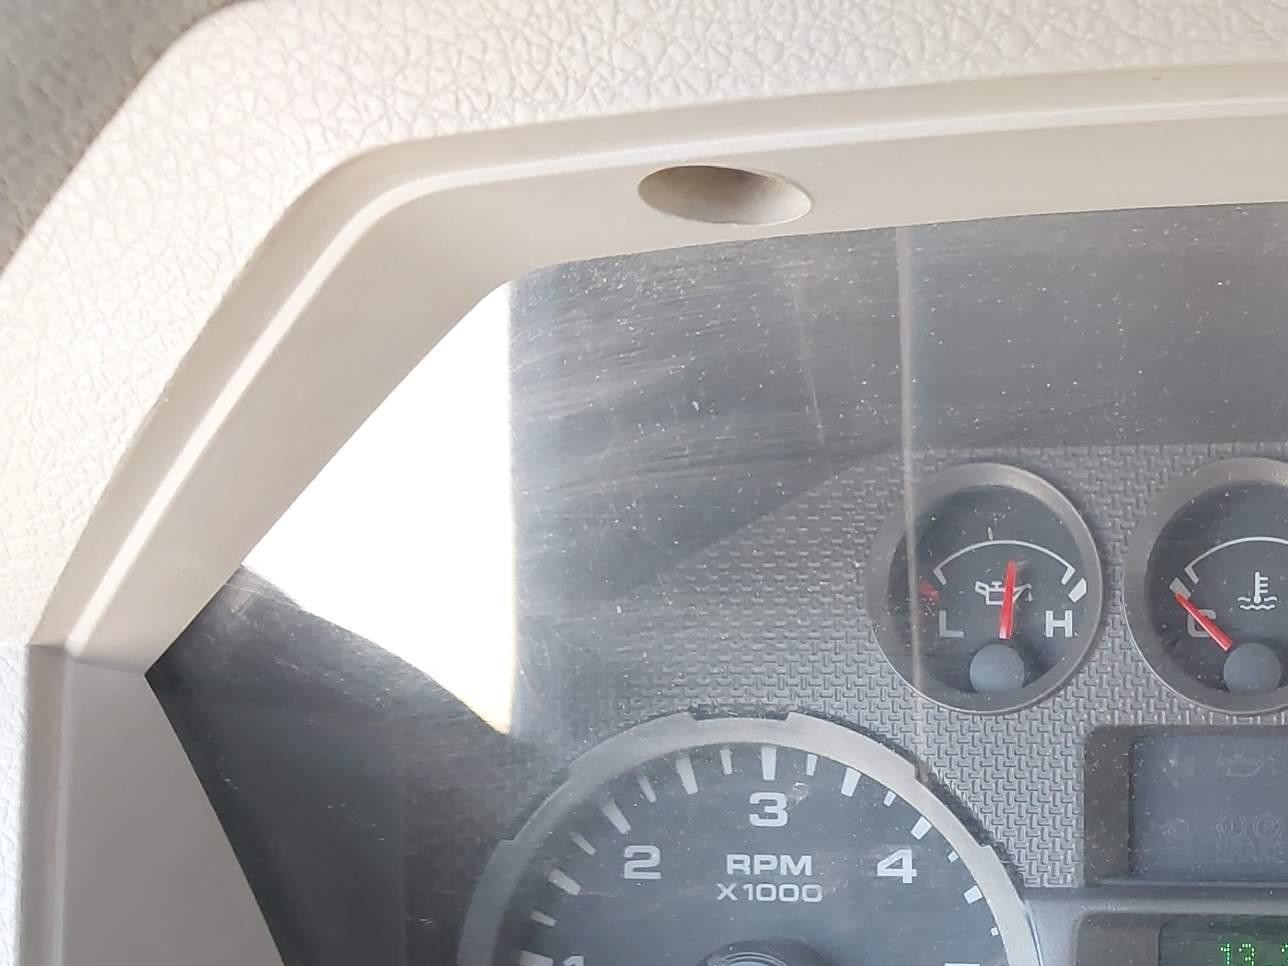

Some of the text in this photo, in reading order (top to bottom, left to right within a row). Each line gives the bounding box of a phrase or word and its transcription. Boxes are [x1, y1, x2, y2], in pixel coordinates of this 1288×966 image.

[939, 611, 964, 638] L
[1046, 610, 1072, 637] H
[1187, 609, 1216, 638] C
[749, 792, 788, 827] 3
[624, 846, 661, 879] 2
[727, 855, 812, 875] RPM
[877, 849, 917, 883] 4
[717, 883, 822, 902] X1000
